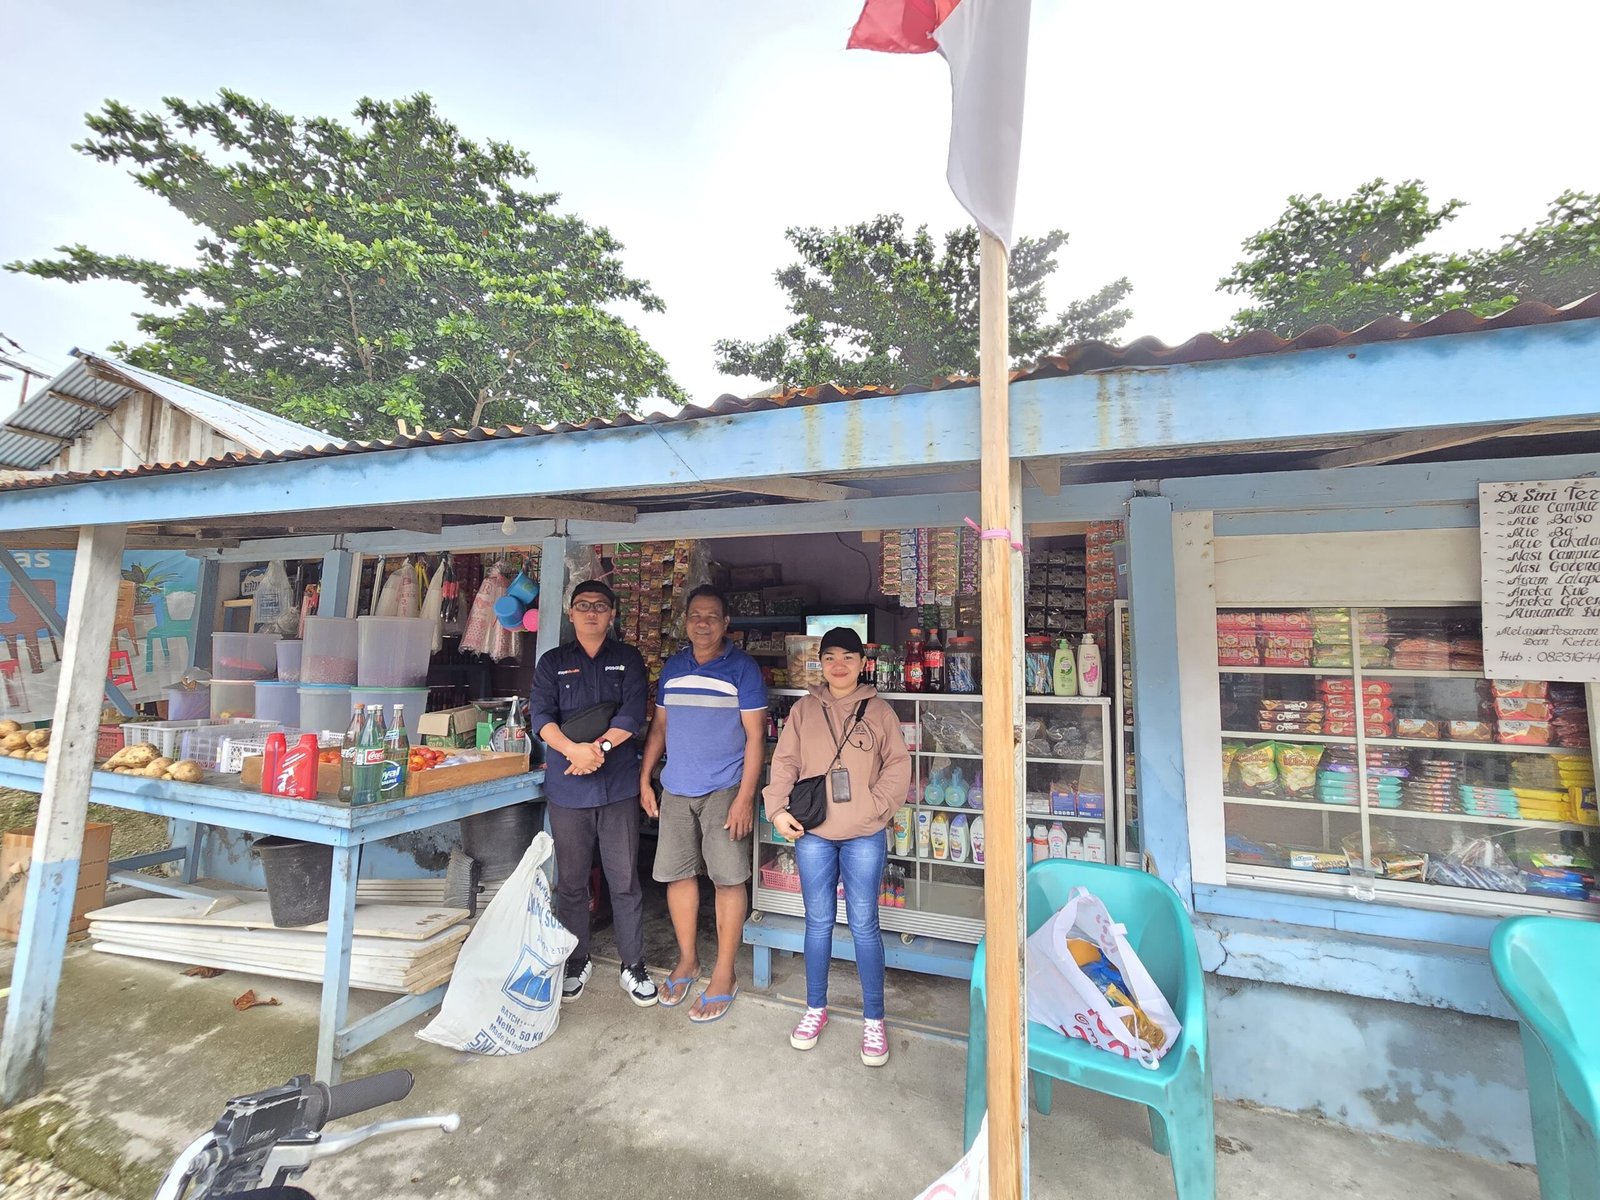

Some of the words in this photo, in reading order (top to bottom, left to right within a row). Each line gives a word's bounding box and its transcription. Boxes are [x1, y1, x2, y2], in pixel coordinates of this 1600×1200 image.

[1494, 490, 1518, 503] Di
[1521, 488, 1557, 502] Sini
[1507, 504, 1540, 515] Mie
[1507, 516, 1539, 526] Mie
[1507, 527, 1540, 538] Mie
[1507, 539, 1542, 549] Mie
[1507, 550, 1542, 561] Nasi
[1505, 562, 1541, 573] Nasi
[1507, 574, 1549, 586] Ayam
[1508, 586, 1553, 597] Aneka
[1561, 585, 1590, 596] Kue
[1506, 597, 1553, 607] Aneka
[1506, 607, 1575, 619] Minuman
[1549, 625, 1599, 636] Pesanan
[1523, 638, 1549, 646] Dan
[1499, 651, 1523, 662] Hub
